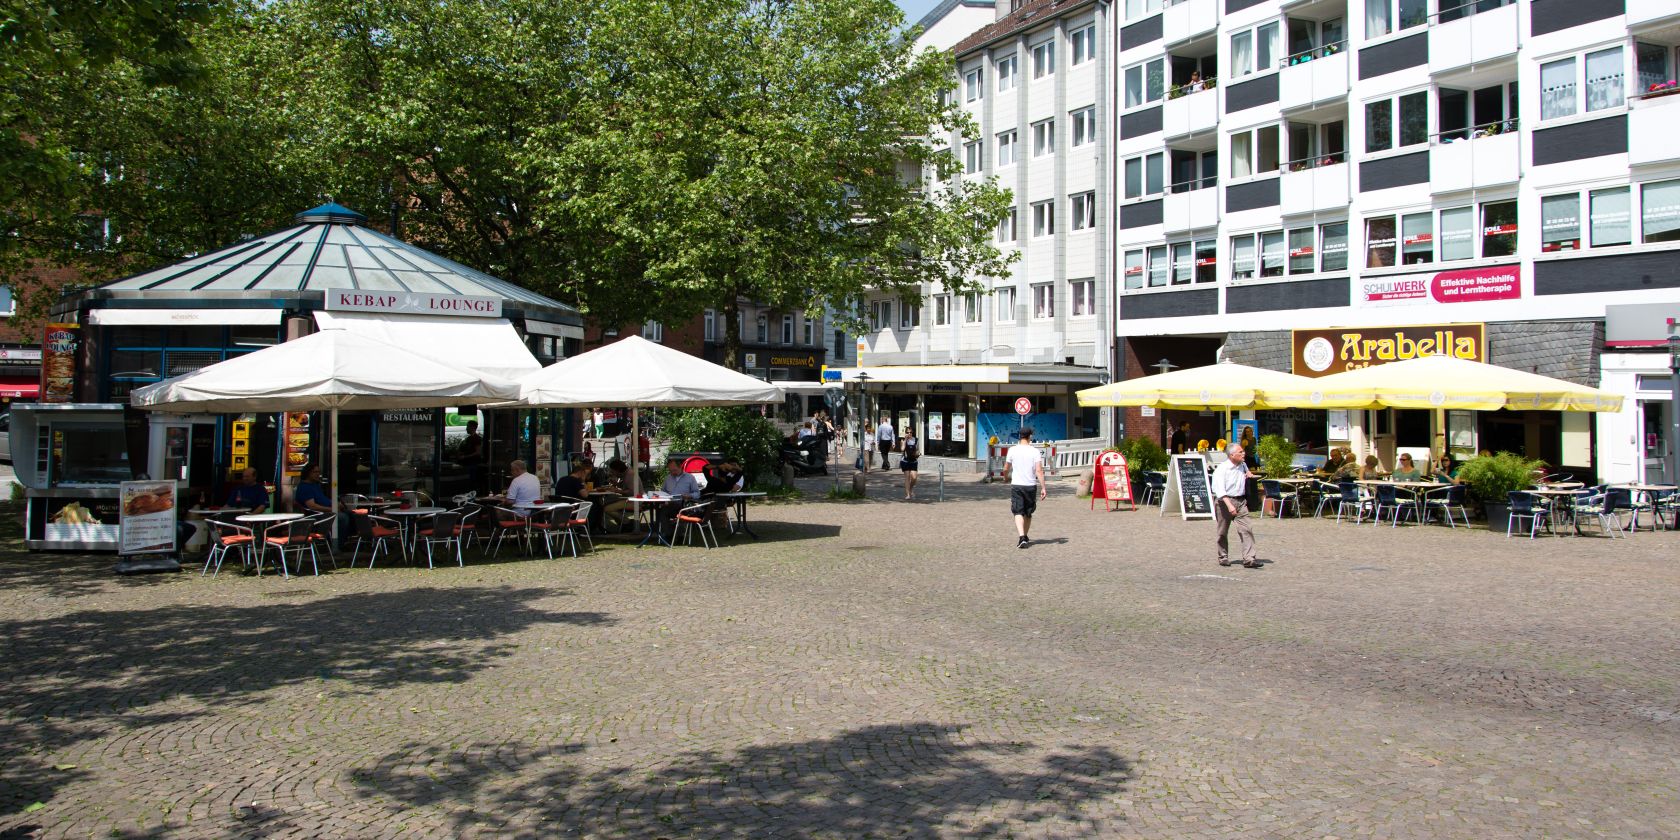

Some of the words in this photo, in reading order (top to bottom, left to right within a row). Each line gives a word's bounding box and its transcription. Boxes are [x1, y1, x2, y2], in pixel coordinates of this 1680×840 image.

[1363, 280, 1427, 295] SCHULWERK
[1440, 278, 1475, 287] Effektive
[1476, 275, 1516, 285] Nachhilfe
[1443, 287, 1459, 296] und
[1460, 283, 1512, 295] Lerntherapie
[340, 293, 397, 308] KEBAP
[430, 298, 495, 312] LOUNGE
[1340, 331, 1476, 360] Arabella
[770, 356, 808, 366] COMMERZBANK
[383, 413, 433, 421] RESTAURANT
